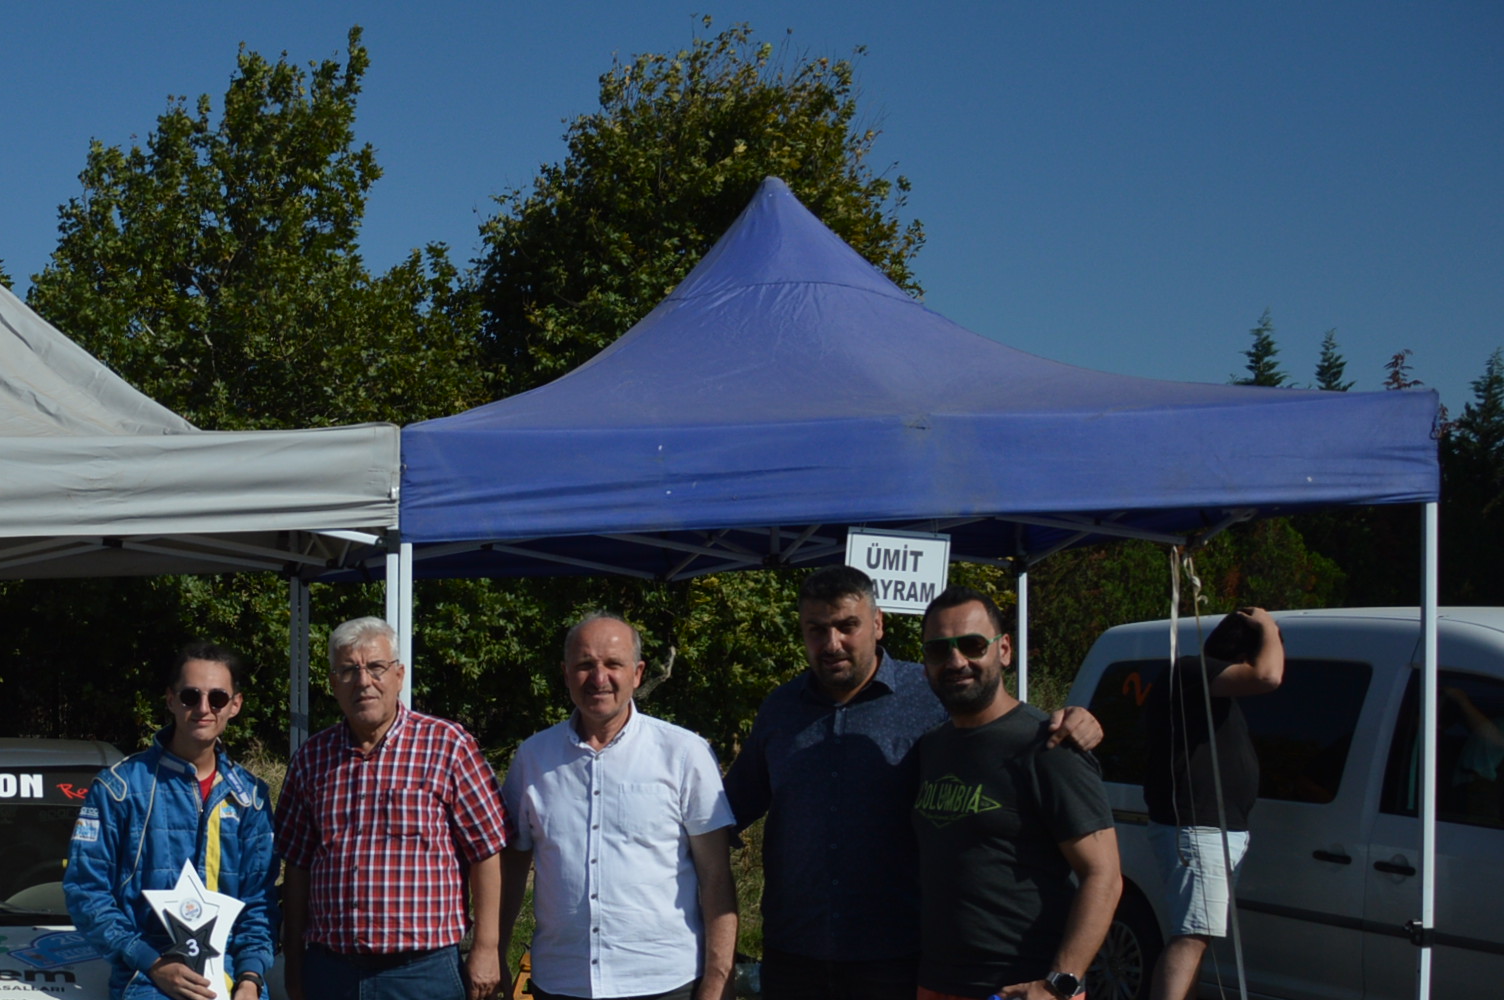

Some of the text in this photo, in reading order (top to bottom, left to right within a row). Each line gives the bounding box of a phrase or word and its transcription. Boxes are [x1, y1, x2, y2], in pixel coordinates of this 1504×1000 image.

[866, 543, 924, 573] ÜMİT
[872, 579, 936, 603] AYRAM
[186, 939, 199, 956] 3
